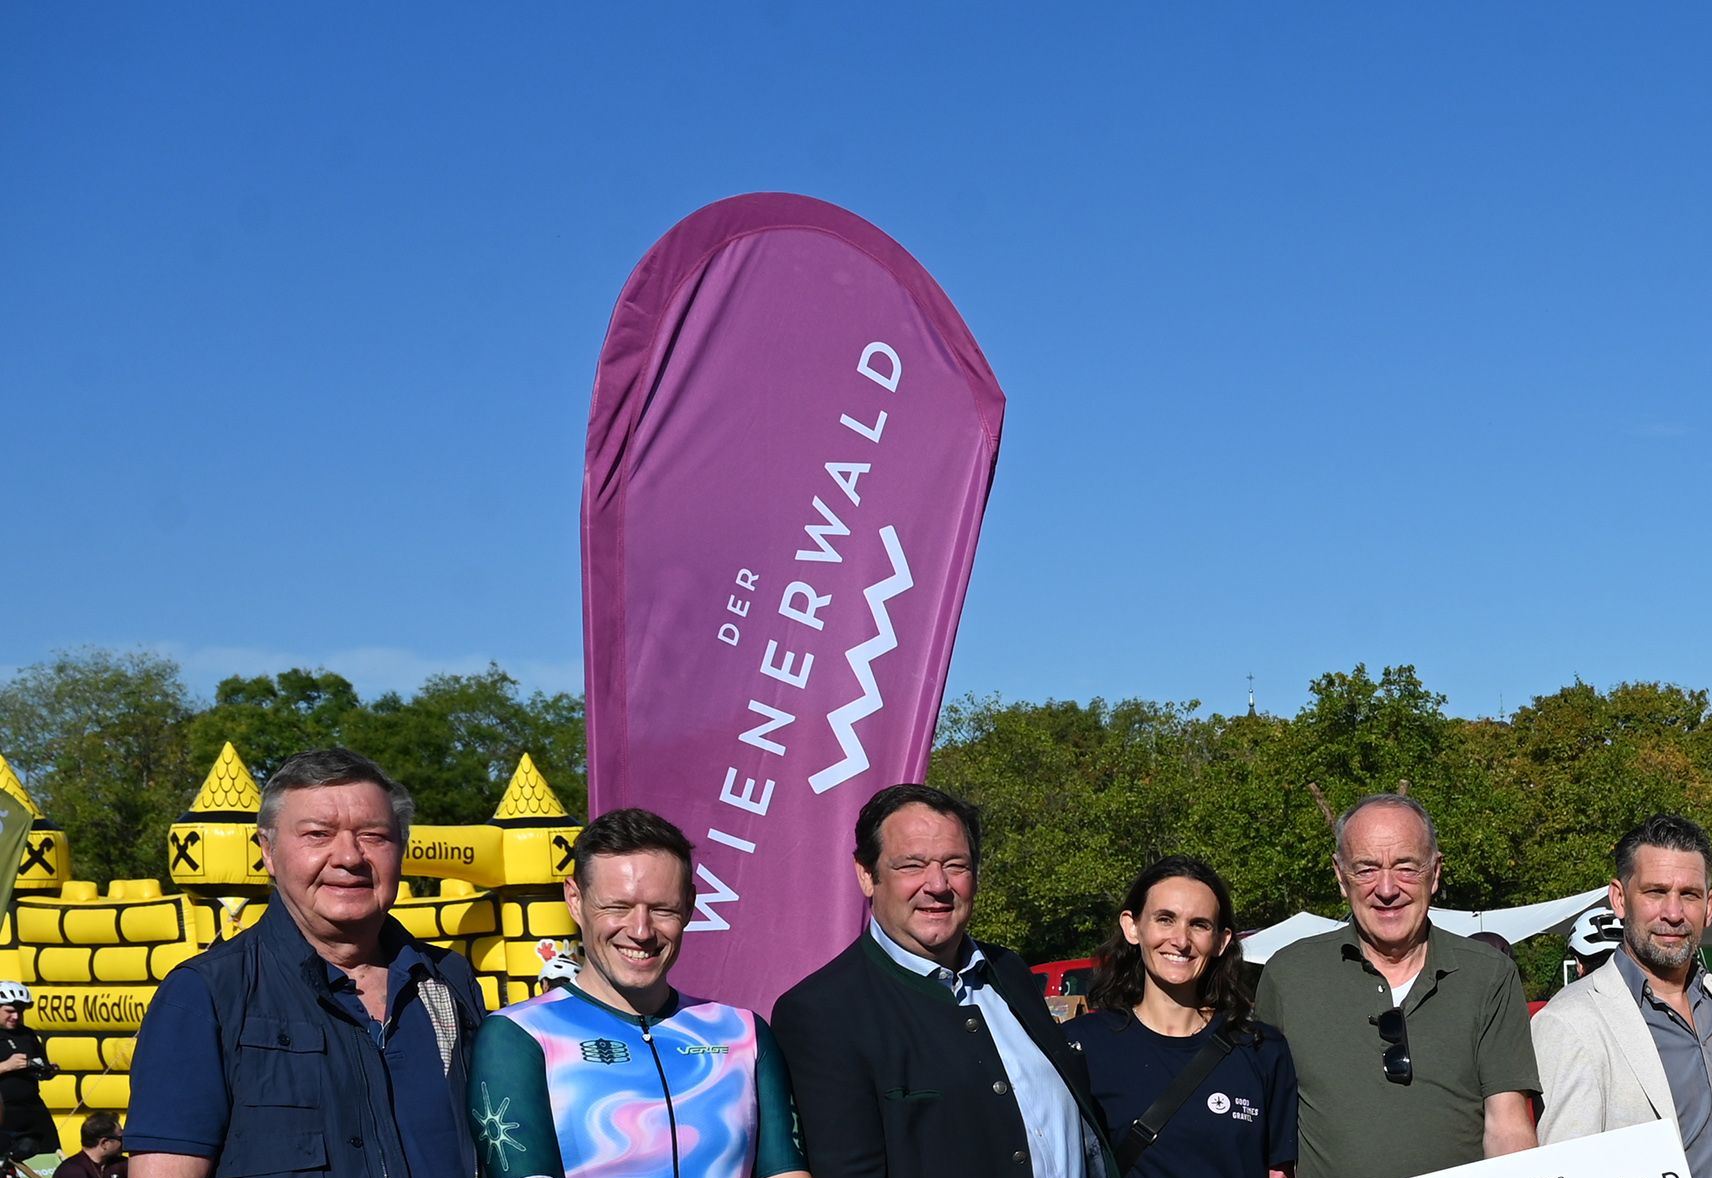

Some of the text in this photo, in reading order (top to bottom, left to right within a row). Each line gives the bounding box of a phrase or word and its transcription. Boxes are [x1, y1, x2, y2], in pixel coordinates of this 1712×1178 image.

[718, 567, 760, 646] DER
[685, 340, 904, 932] WIENERWALD
[405, 840, 475, 864] ödling
[38, 993, 149, 1023] RRB Mödlin
